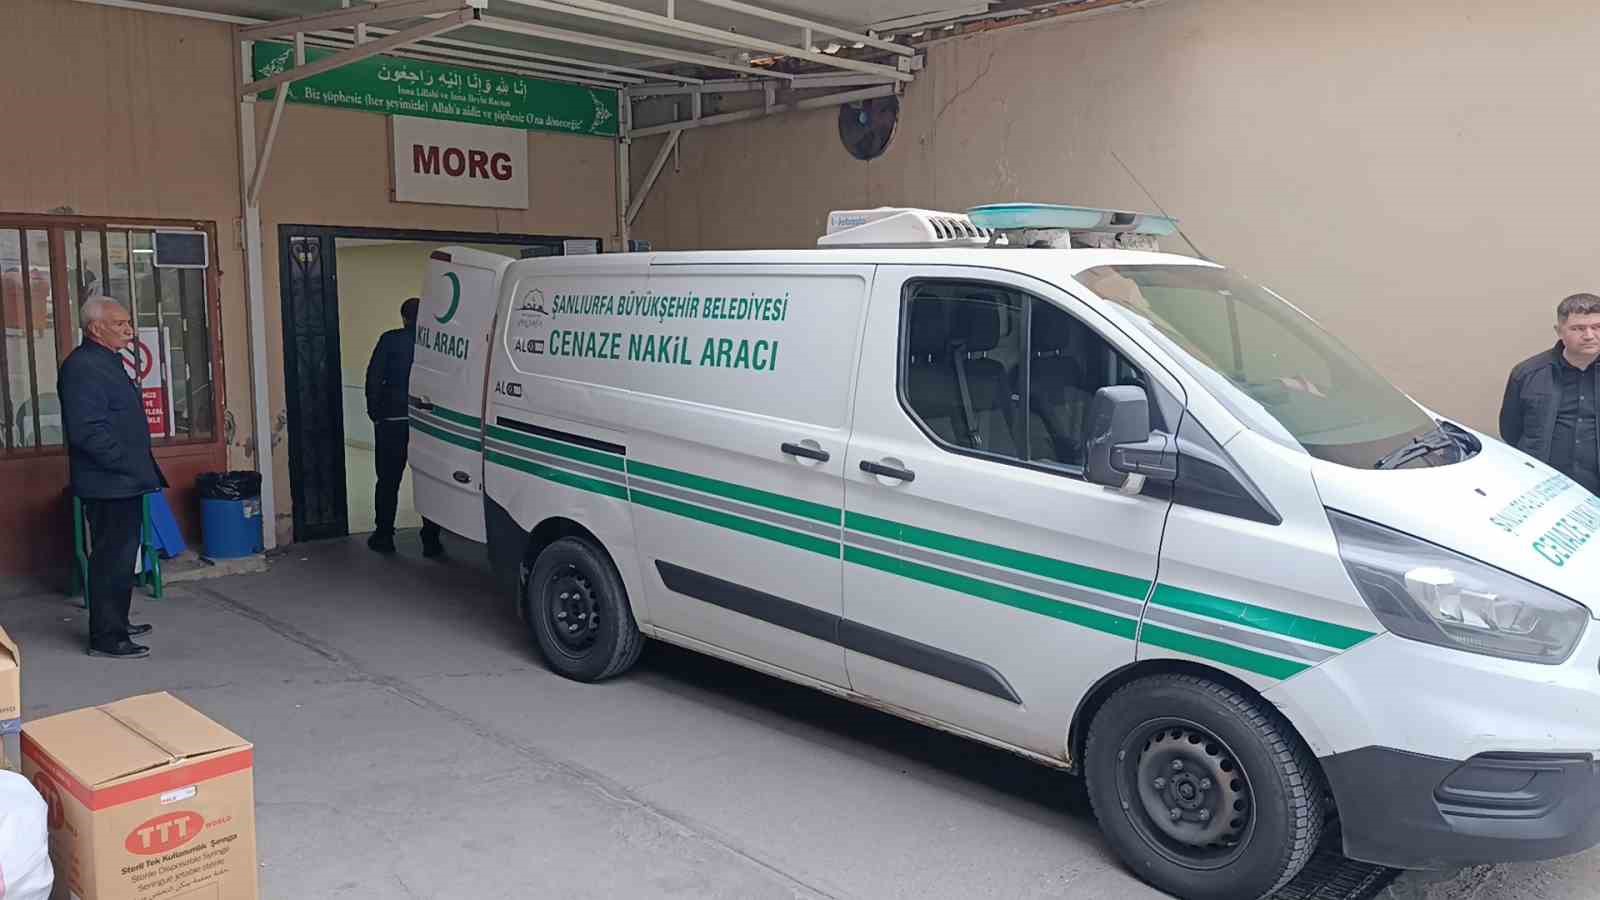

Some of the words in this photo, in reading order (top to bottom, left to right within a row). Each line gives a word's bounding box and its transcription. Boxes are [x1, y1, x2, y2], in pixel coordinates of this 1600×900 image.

[304, 87, 321, 100] Biz
[322, 90, 362, 105] şüphesiz
[364, 93, 385, 107] (her
[412, 144, 513, 181] MORG
[552, 293, 614, 320] ŞANLIURFA
[616, 290, 699, 324] BÜYÜKŞEHİR
[702, 291, 789, 322] BELEDİYESİ
[433, 331, 470, 361] ARACI
[549, 329, 622, 360] CENAZE
[700, 337, 778, 371] ARACI
[137, 815, 191, 849] TTT
[121, 862, 145, 876] Steril
[146, 857, 161, 868] Tek
